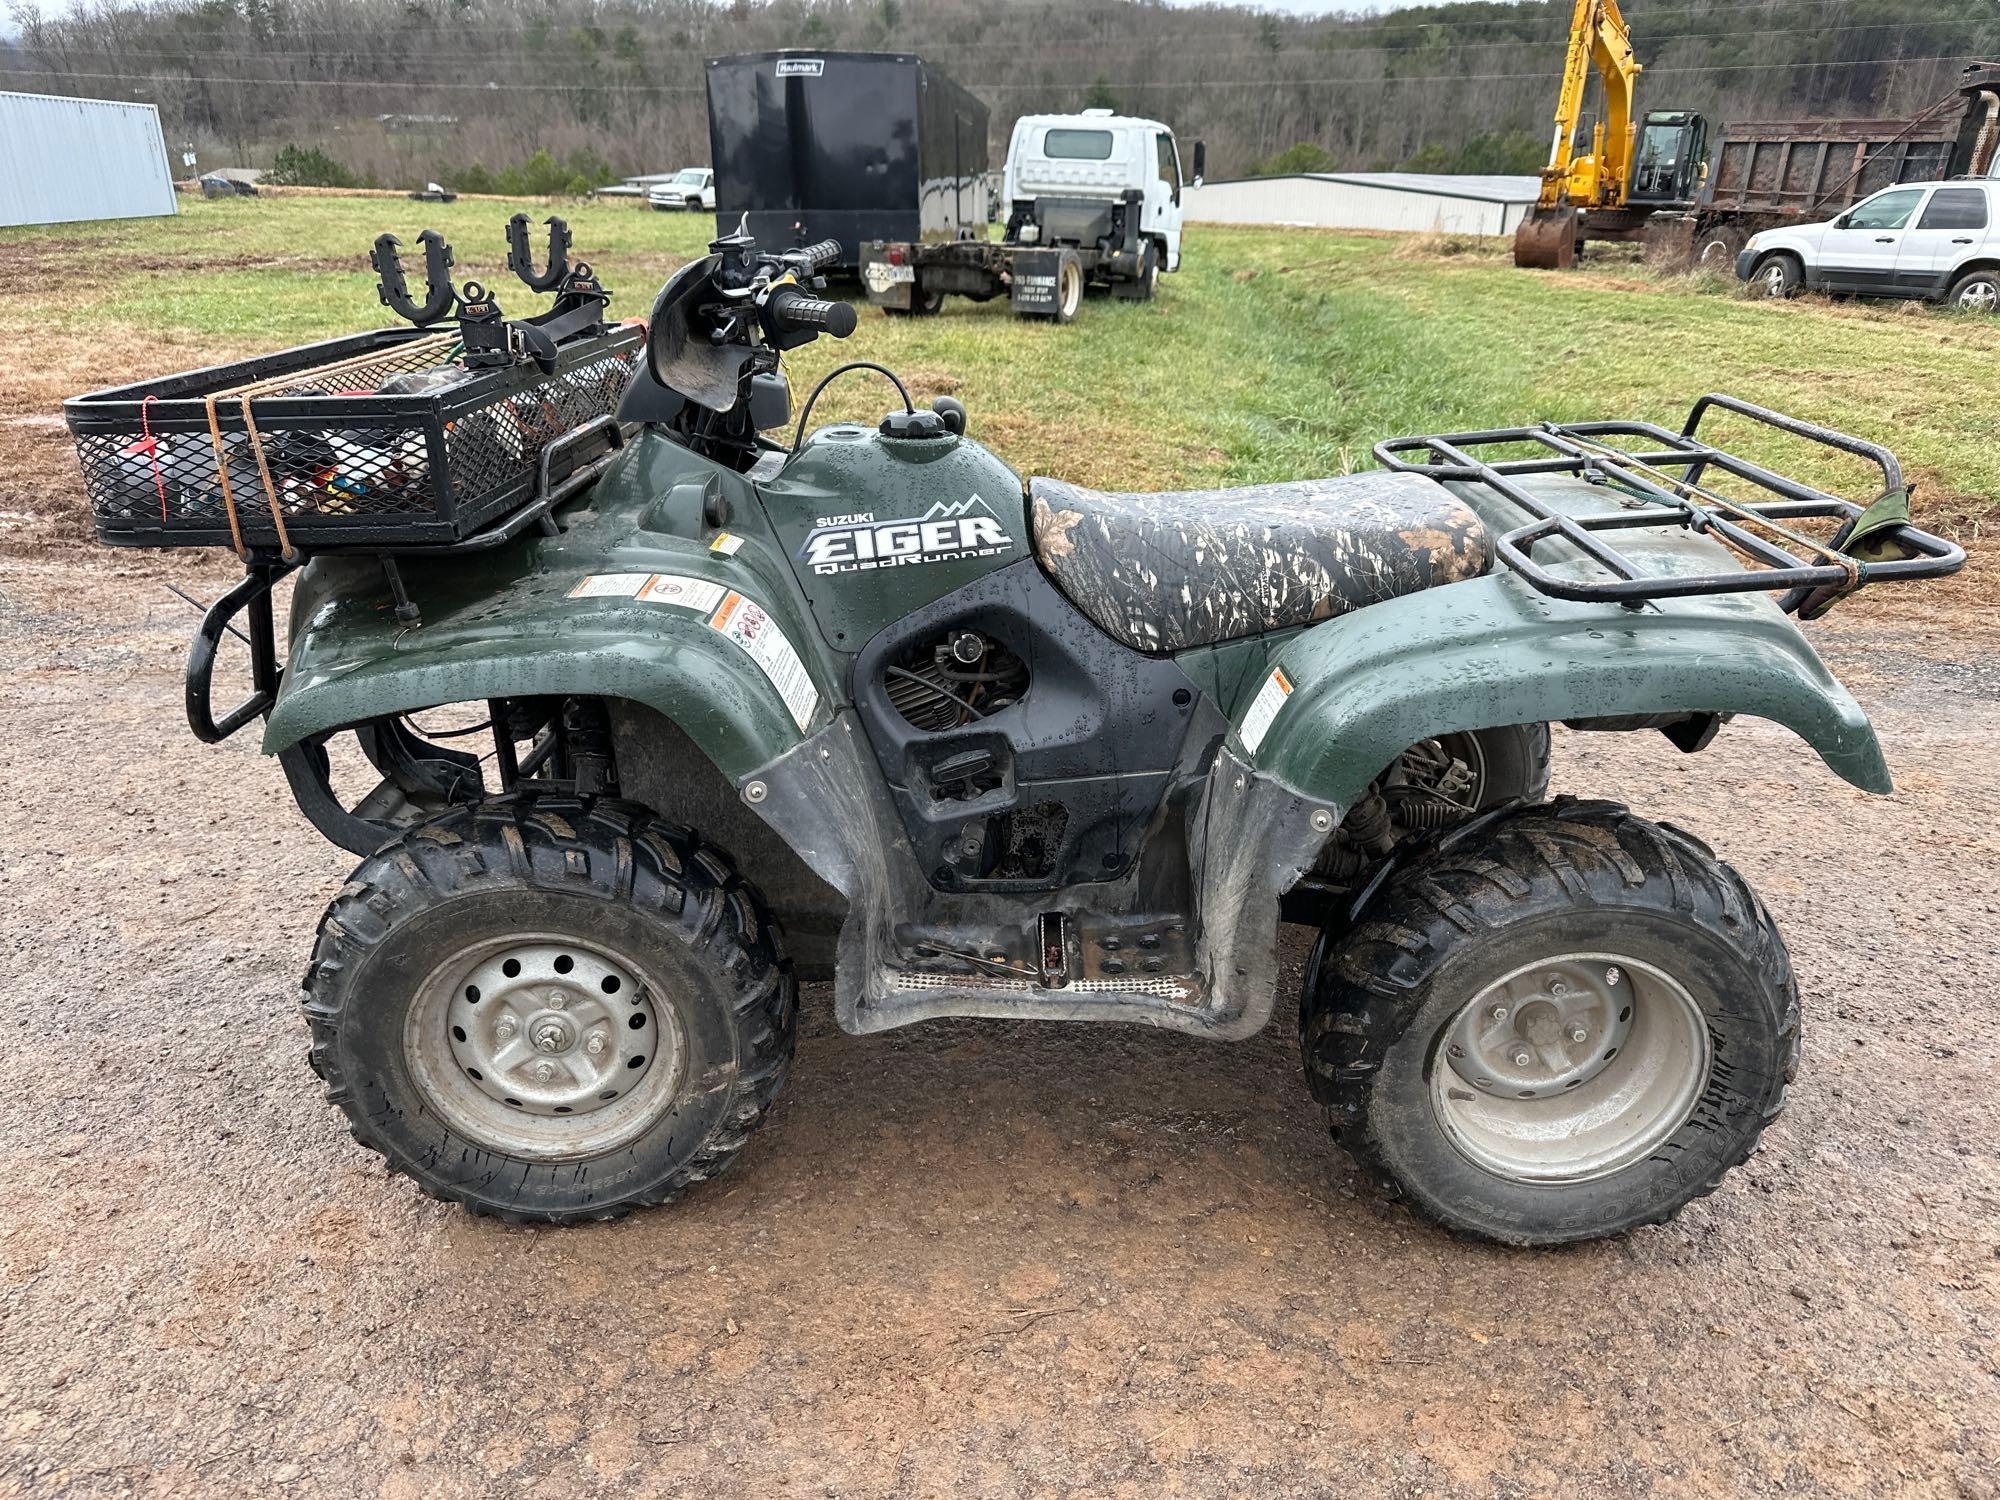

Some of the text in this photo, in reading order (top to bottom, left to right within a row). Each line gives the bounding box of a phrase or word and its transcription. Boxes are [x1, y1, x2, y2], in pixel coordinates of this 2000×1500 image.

[816, 512, 875, 528] SUZUKI
[806, 516, 1014, 566] EIGER
[814, 545, 1013, 576] QuadRunner
